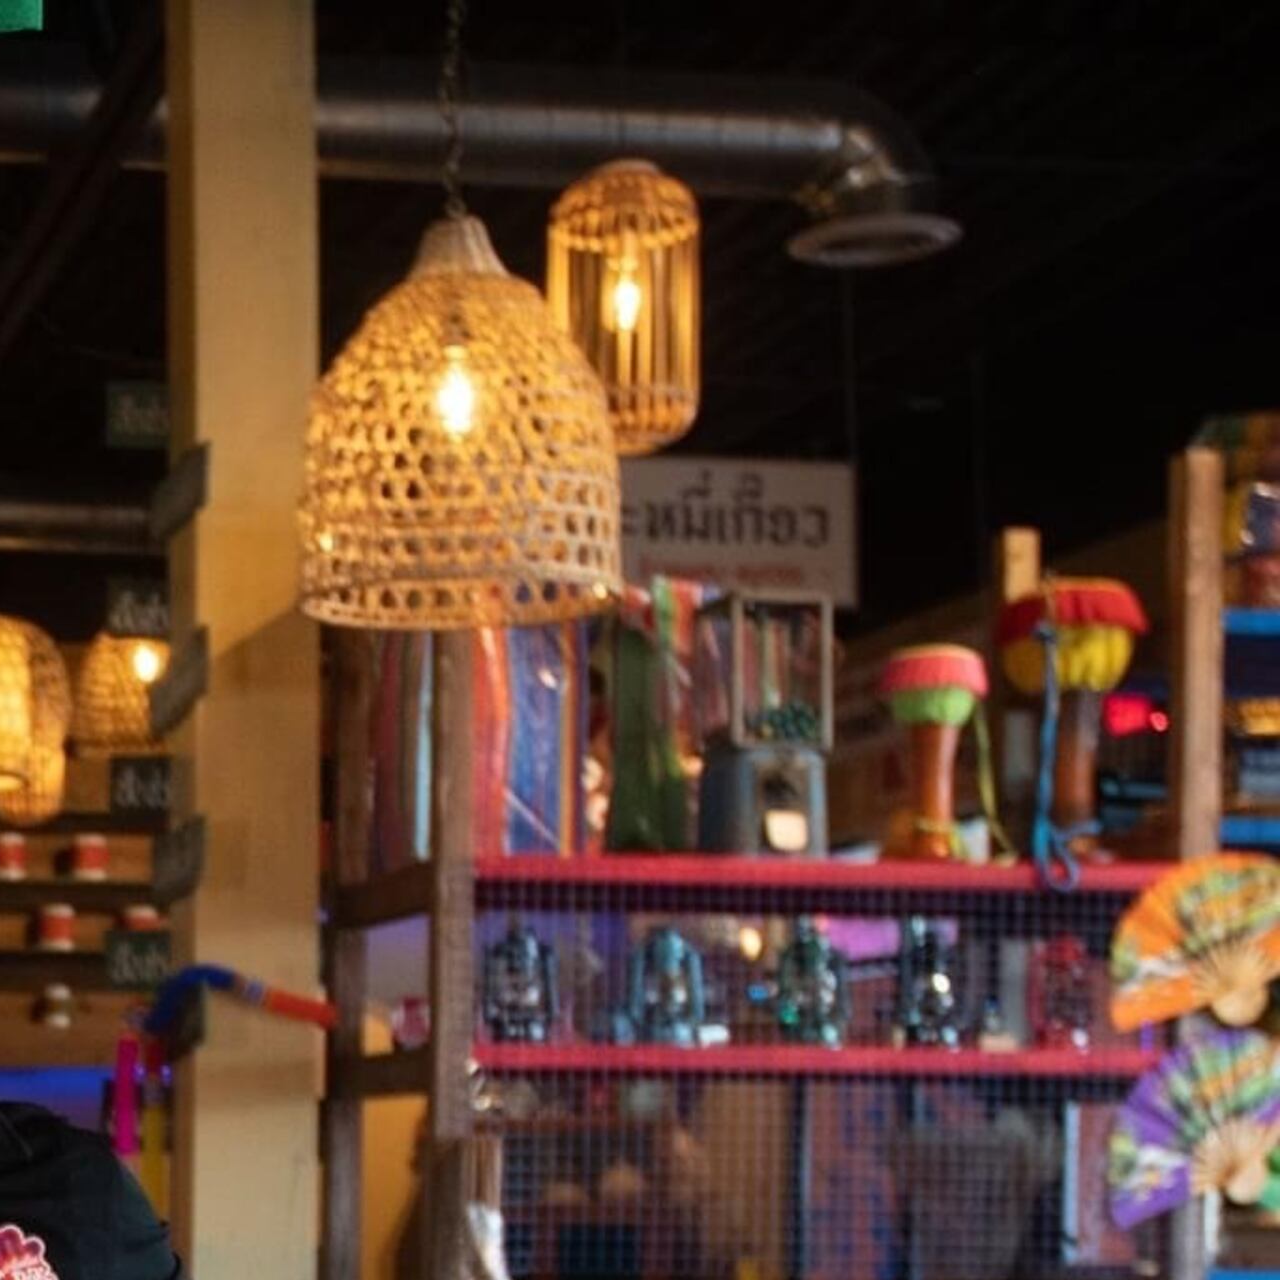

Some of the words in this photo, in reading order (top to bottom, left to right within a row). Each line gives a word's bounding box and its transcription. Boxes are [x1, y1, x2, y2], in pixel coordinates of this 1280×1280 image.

[620, 468, 831, 549] ะหมี่เกี๊ยว
